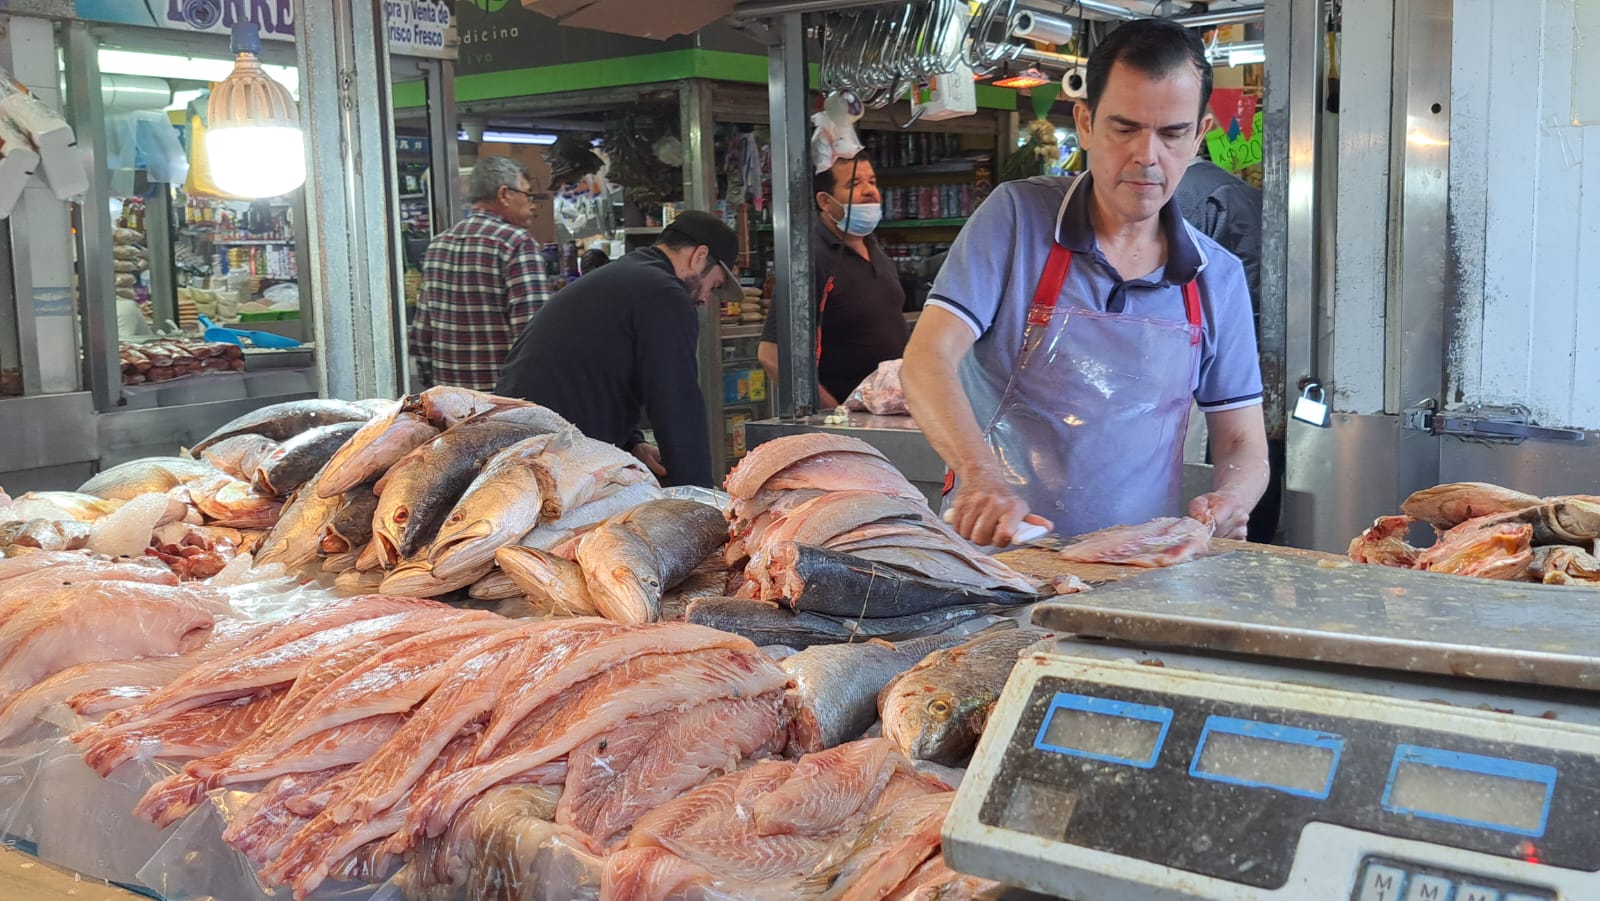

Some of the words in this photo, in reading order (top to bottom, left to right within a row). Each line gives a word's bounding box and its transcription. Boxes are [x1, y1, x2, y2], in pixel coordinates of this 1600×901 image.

[411, 0, 436, 22] Venta
[438, 4, 449, 24] de
[414, 24, 443, 46] Fresco
[1374, 873, 1392, 890] M
[1420, 883, 1438, 900] M
